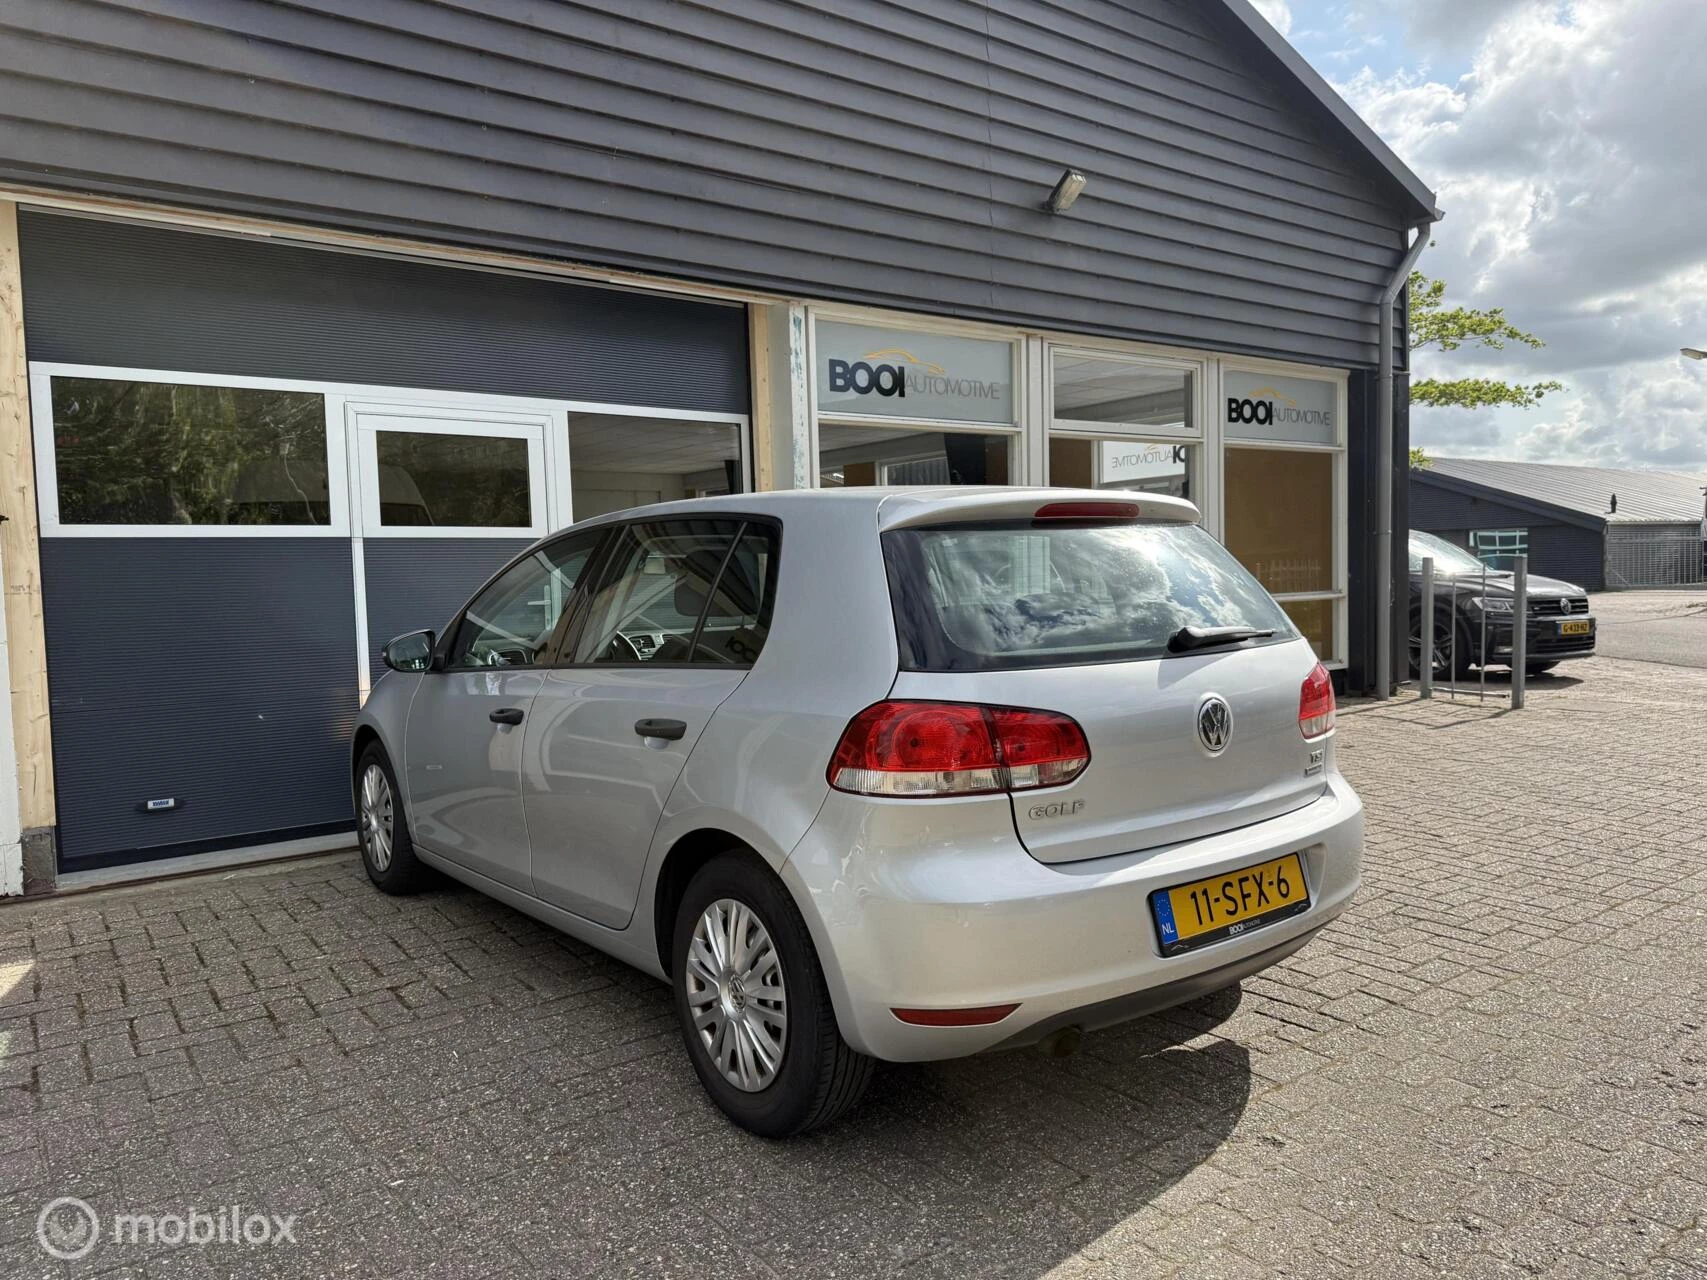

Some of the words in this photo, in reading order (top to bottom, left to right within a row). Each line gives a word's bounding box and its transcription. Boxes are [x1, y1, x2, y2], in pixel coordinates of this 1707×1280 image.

[828, 358, 906, 398] BOOI
[905, 372, 1001, 400] AUTOMOTIVE
[1227, 397, 1273, 426] BOOI
[1272, 408, 1332, 426] AUTOMOTIVE
[1028, 799, 1086, 821] GOLF
[1190, 865, 1290, 926] 11-SFX-6
[1161, 922, 1175, 935] NL
